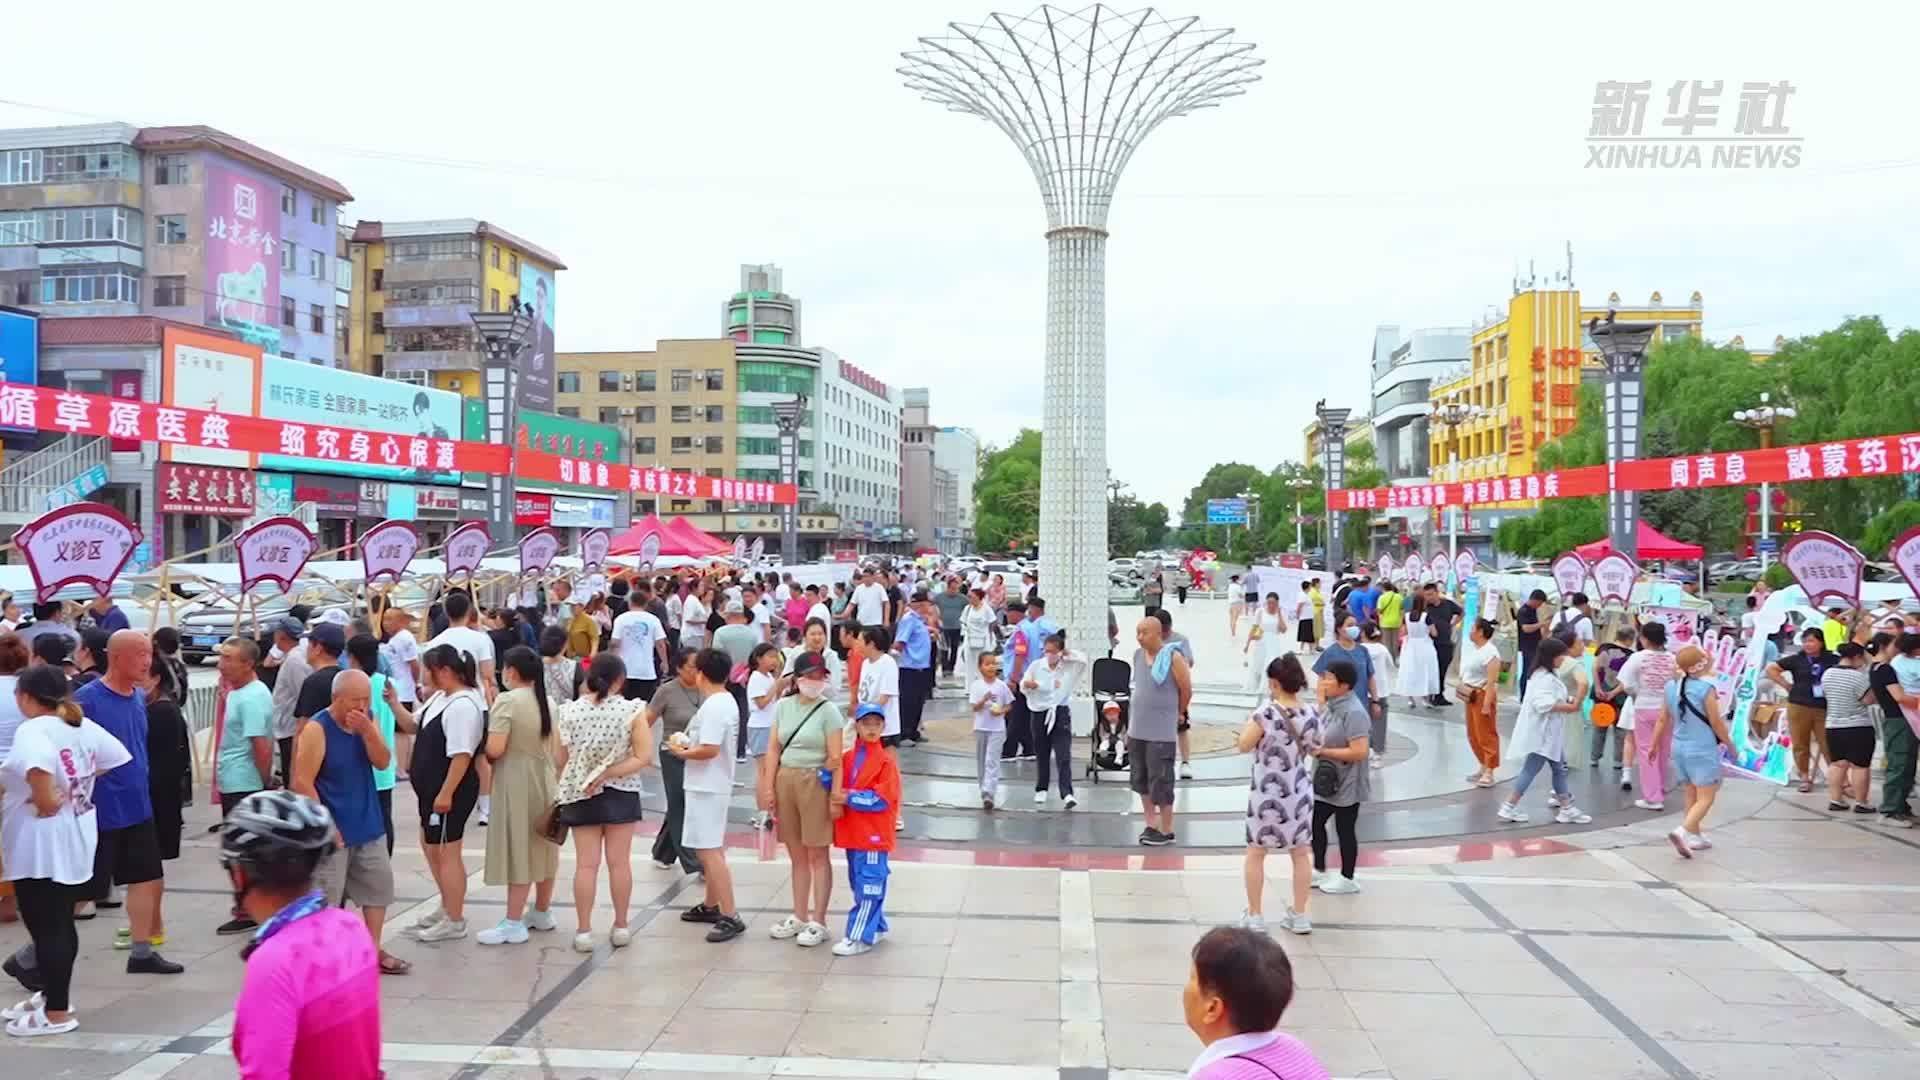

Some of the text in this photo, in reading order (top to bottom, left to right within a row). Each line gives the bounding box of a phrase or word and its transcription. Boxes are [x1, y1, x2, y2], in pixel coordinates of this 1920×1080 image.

[0, 385, 230, 448] 循草原医典
[280, 423, 456, 468] 细究身心根源
[1670, 453, 1747, 487] 闻声息
[53, 540, 105, 563] 义诊区
[255, 545, 292, 563] 义诊区
